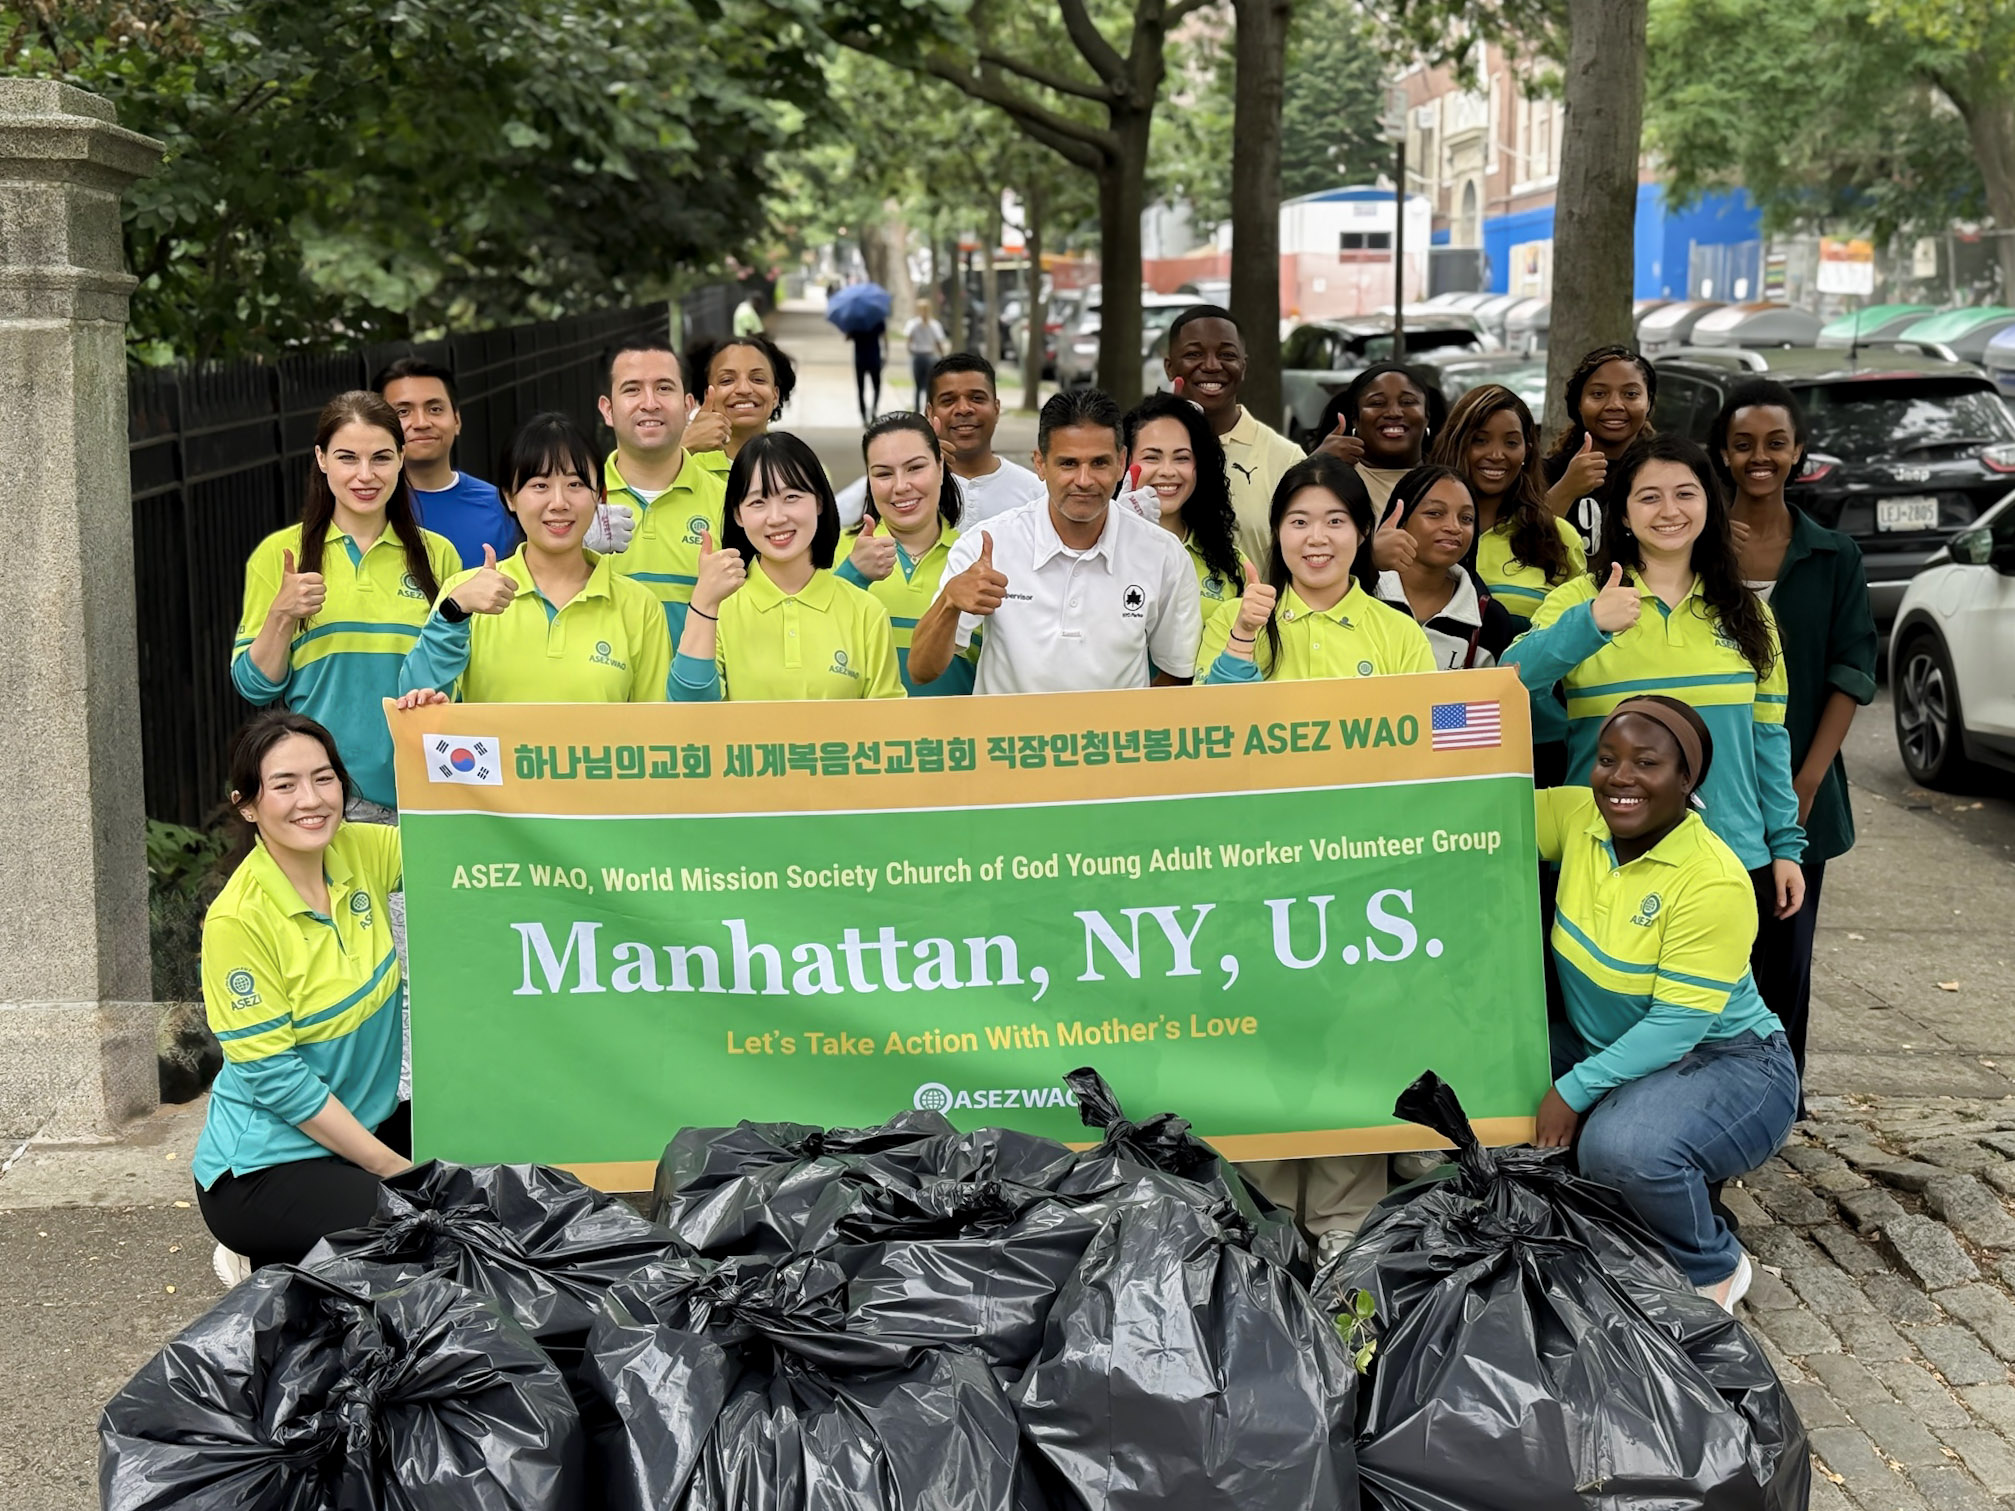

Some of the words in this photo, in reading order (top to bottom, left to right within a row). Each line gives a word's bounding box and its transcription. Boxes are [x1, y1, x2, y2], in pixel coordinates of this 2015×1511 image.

[681, 535, 704, 545] ASE
[514, 743, 712, 781] 하나님의교회
[722, 737, 977, 777] 세계복음선교협회
[987, 725, 1235, 769] 직장인청년봉사단
[1243, 720, 1331, 756] ASEZ
[1339, 714, 1419, 749] WAO
[451, 863, 522, 889] ASEZ
[528, 864, 593, 895] WAO,
[601, 865, 674, 893] World
[680, 865, 778, 892] Mission
[786, 861, 878, 893] Society
[886, 856, 972, 885] Church
[979, 855, 1004, 881] of
[1012, 853, 1059, 880] God
[1065, 851, 1142, 881] Young
[1148, 845, 1213, 873] Adult
[1218, 840, 1303, 868] Worker
[1309, 835, 1425, 862] Volunteer
[1432, 828, 1501, 857] Group
[511, 918, 1050, 1003] Manhattan,
[1073, 903, 1240, 991] NY,
[1263, 888, 1445, 970] U.S.
[727, 1029, 797, 1056] Let's
[803, 1031, 875, 1056] Take
[884, 1029, 978, 1056] Action
[985, 1024, 1050, 1050] With
[1056, 1014, 1182, 1047] Mother's
[1190, 1012, 1258, 1039] Love
